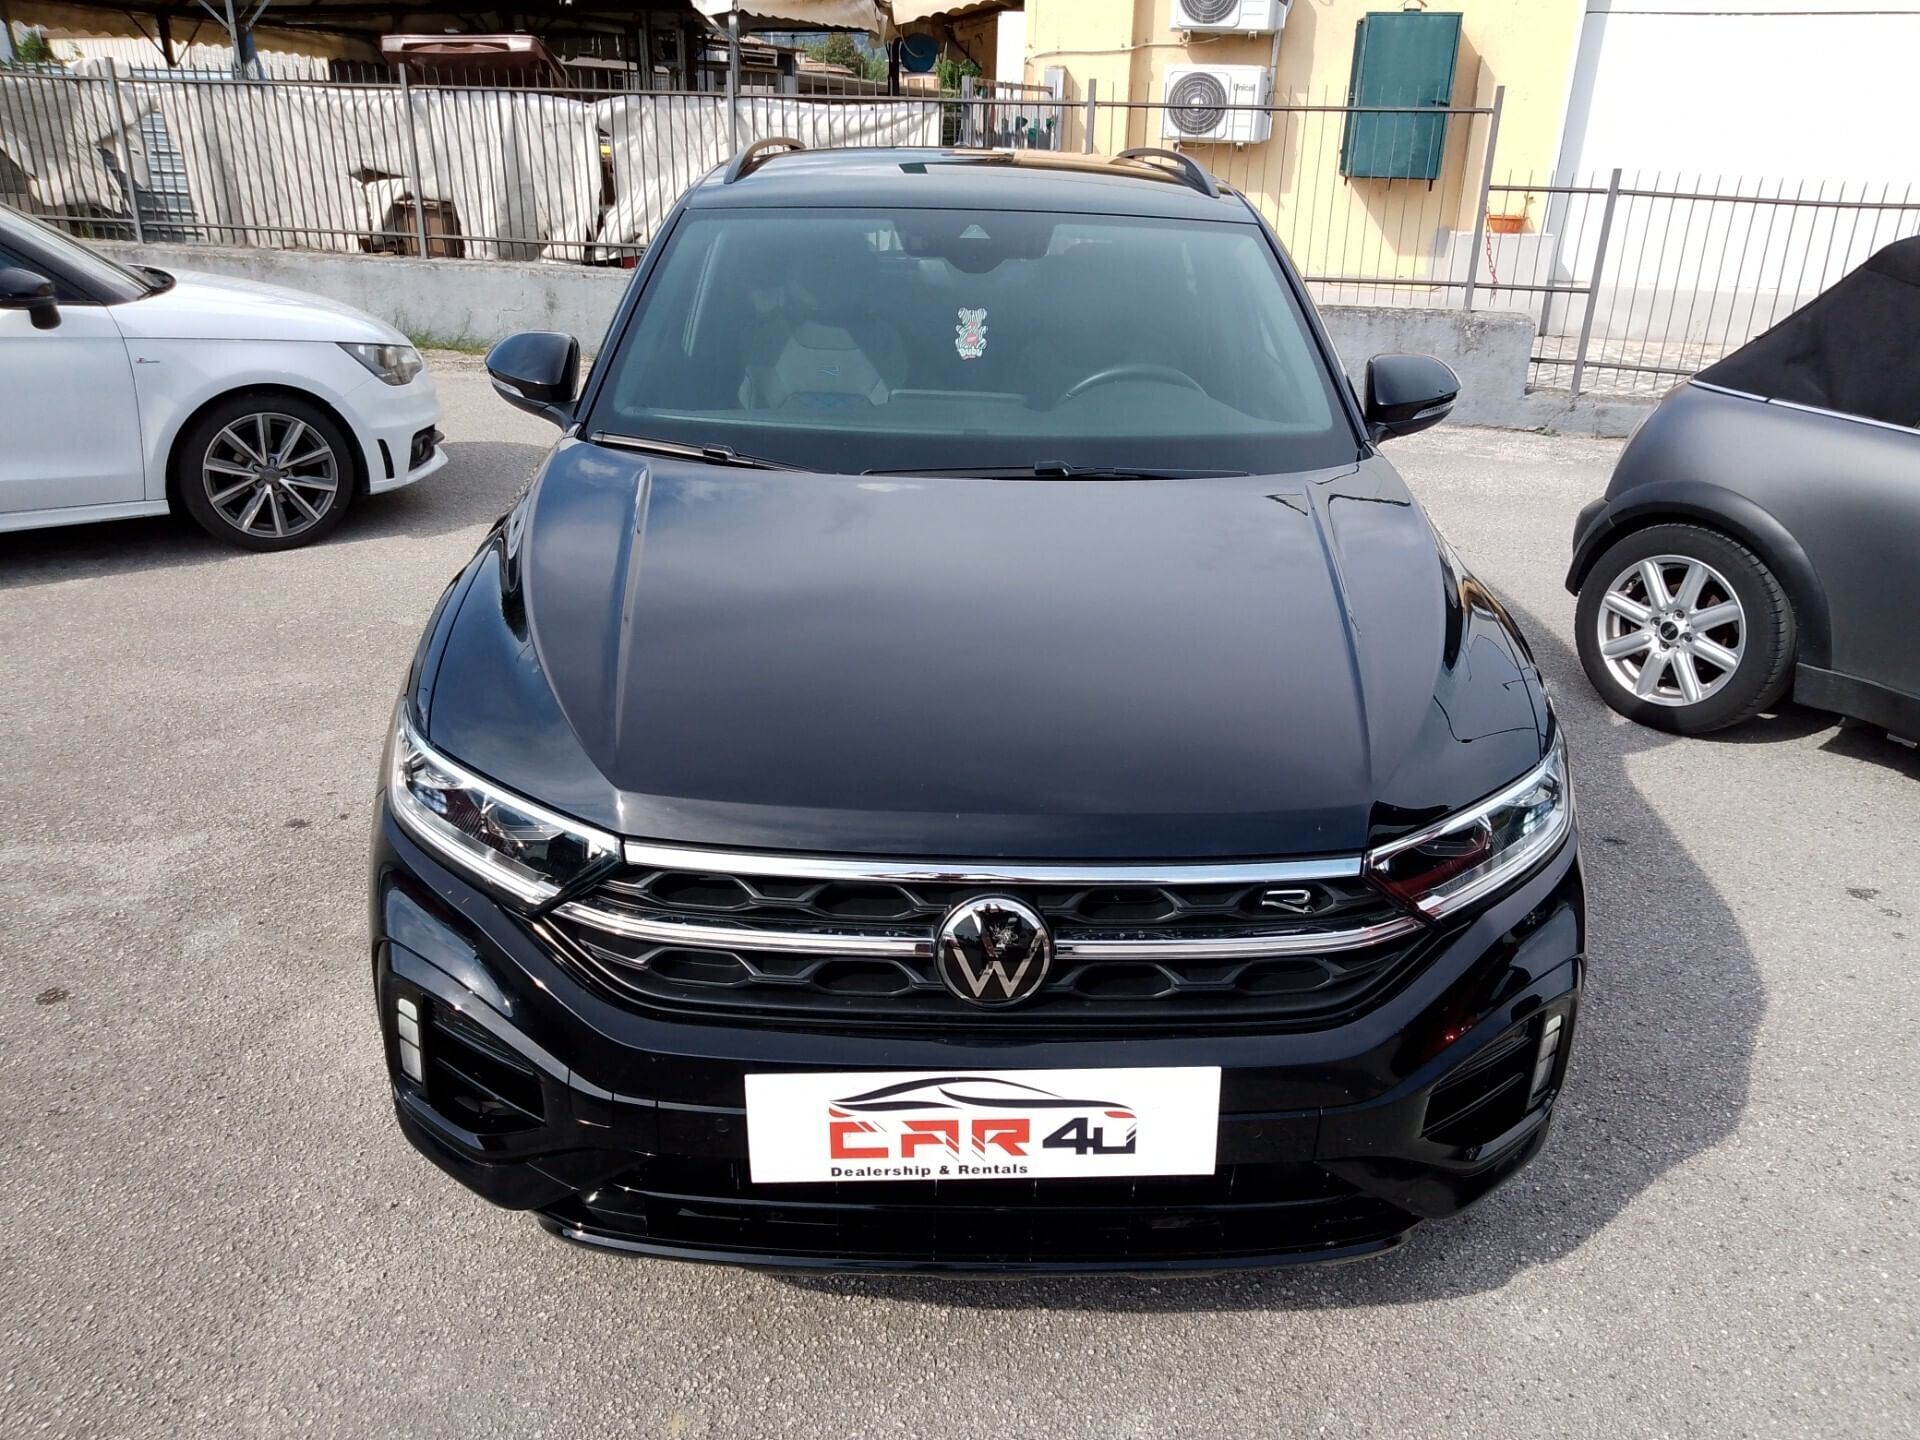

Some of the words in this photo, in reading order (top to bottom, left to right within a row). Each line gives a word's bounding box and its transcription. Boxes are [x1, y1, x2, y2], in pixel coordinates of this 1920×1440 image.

[829, 1119, 1031, 1161] CAR
[830, 1165, 931, 1178] Dealership
[939, 1165, 950, 1175] &
[958, 1163, 1029, 1175] Rentals
